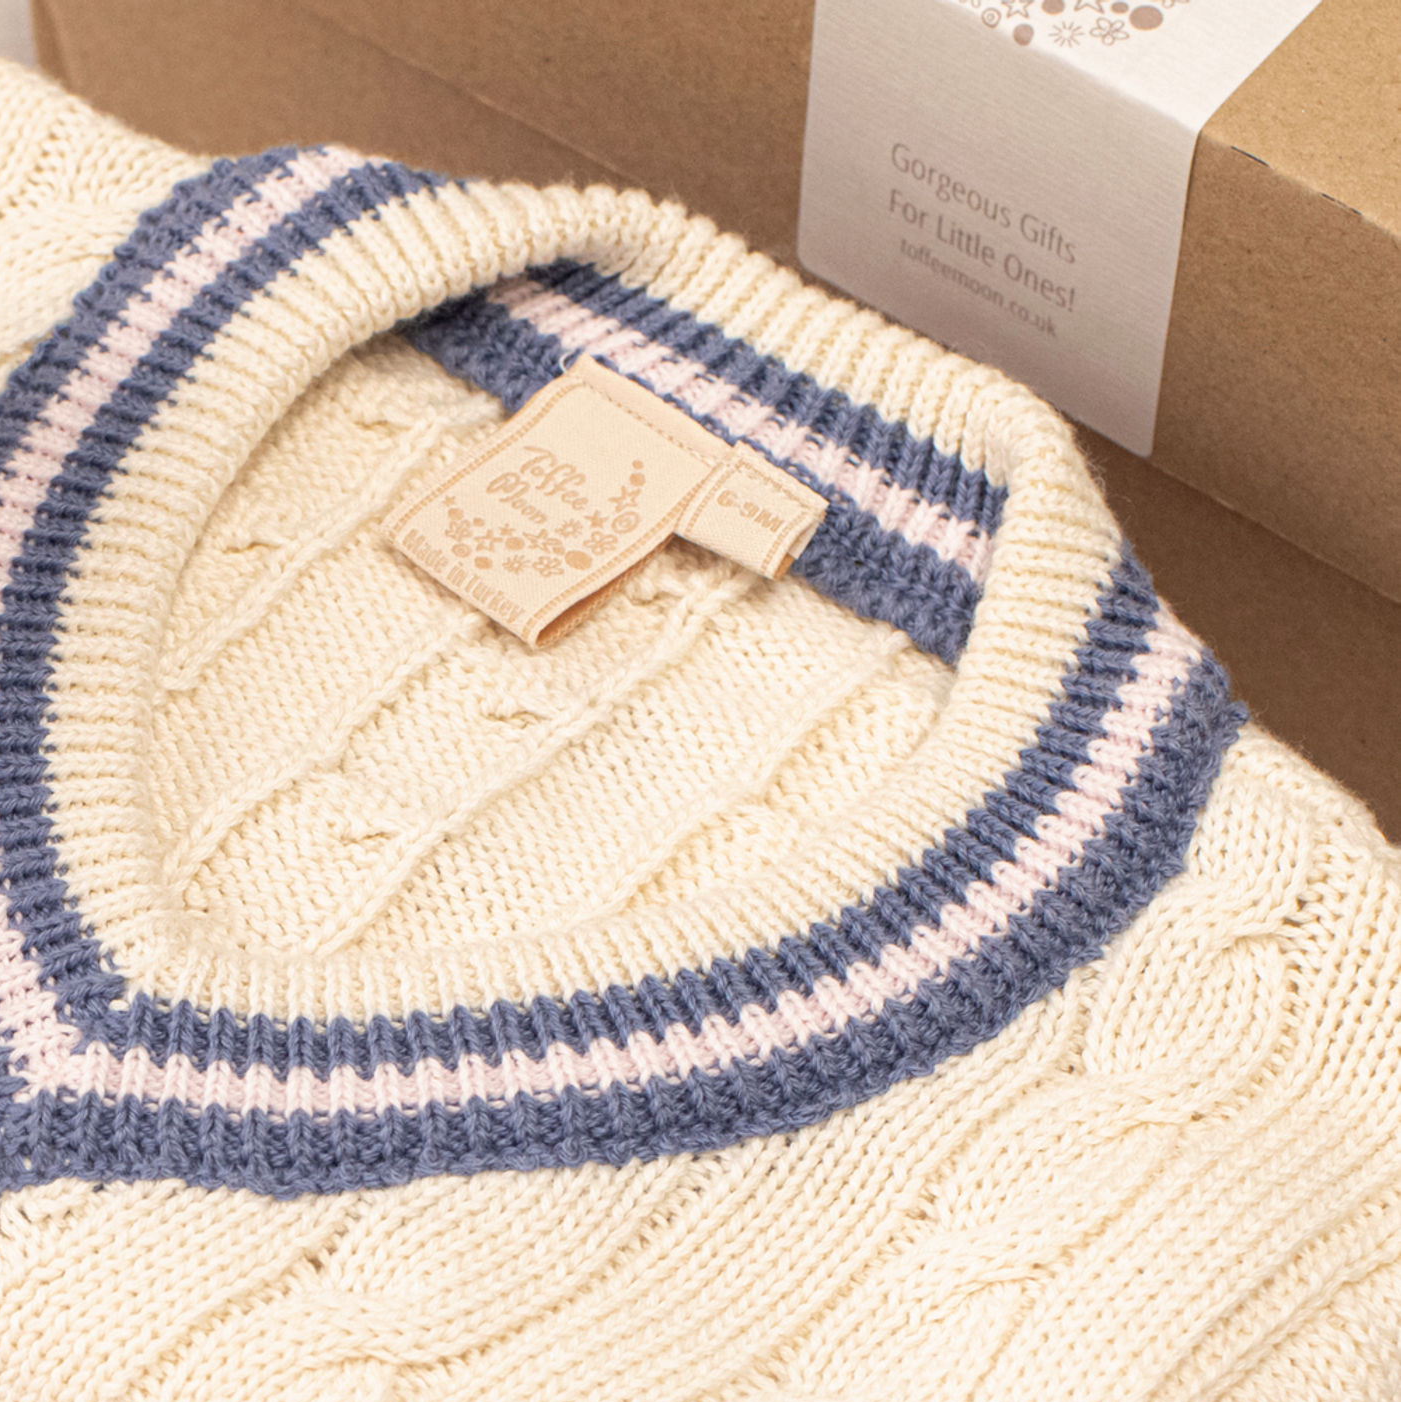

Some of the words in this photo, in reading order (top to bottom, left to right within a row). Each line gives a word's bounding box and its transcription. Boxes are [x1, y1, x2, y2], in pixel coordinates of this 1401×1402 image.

[891, 142, 1011, 229] Gorgeous
[1020, 212, 1077, 264] Gifts
[889, 188, 928, 229] For
[936, 215, 996, 268] Little
[1004, 251, 1076, 313] Ones!
[901, 239, 1056, 338] toffeemoon.co.uk
[485, 472, 548, 524] Moon
[519, 445, 589, 511] Toffee
[717, 490, 784, 533] 6-9M
[401, 528, 448, 573] Made
